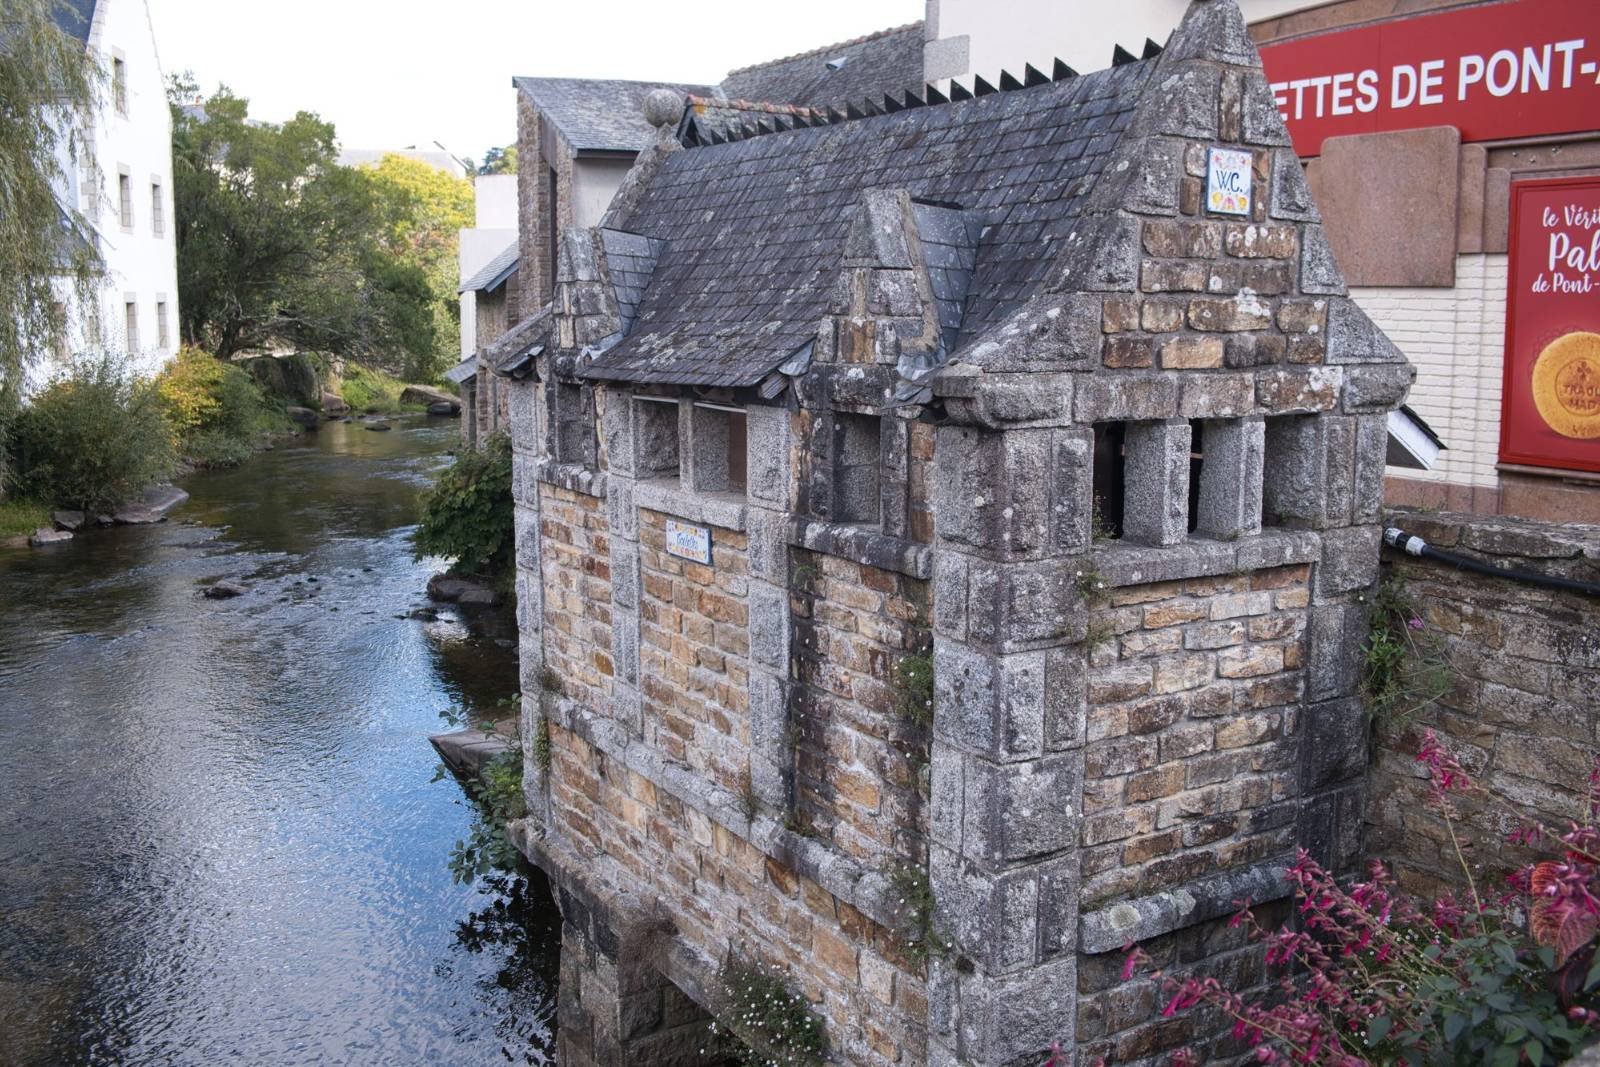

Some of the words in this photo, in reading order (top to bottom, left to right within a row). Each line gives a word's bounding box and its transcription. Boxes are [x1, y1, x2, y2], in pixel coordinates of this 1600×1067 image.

[1391, 60, 1444, 109] DE
[1458, 39, 1600, 101] PONT-
[1543, 206, 1559, 227] le
[1564, 204, 1600, 229] Véri
[1532, 273, 1550, 293] de
